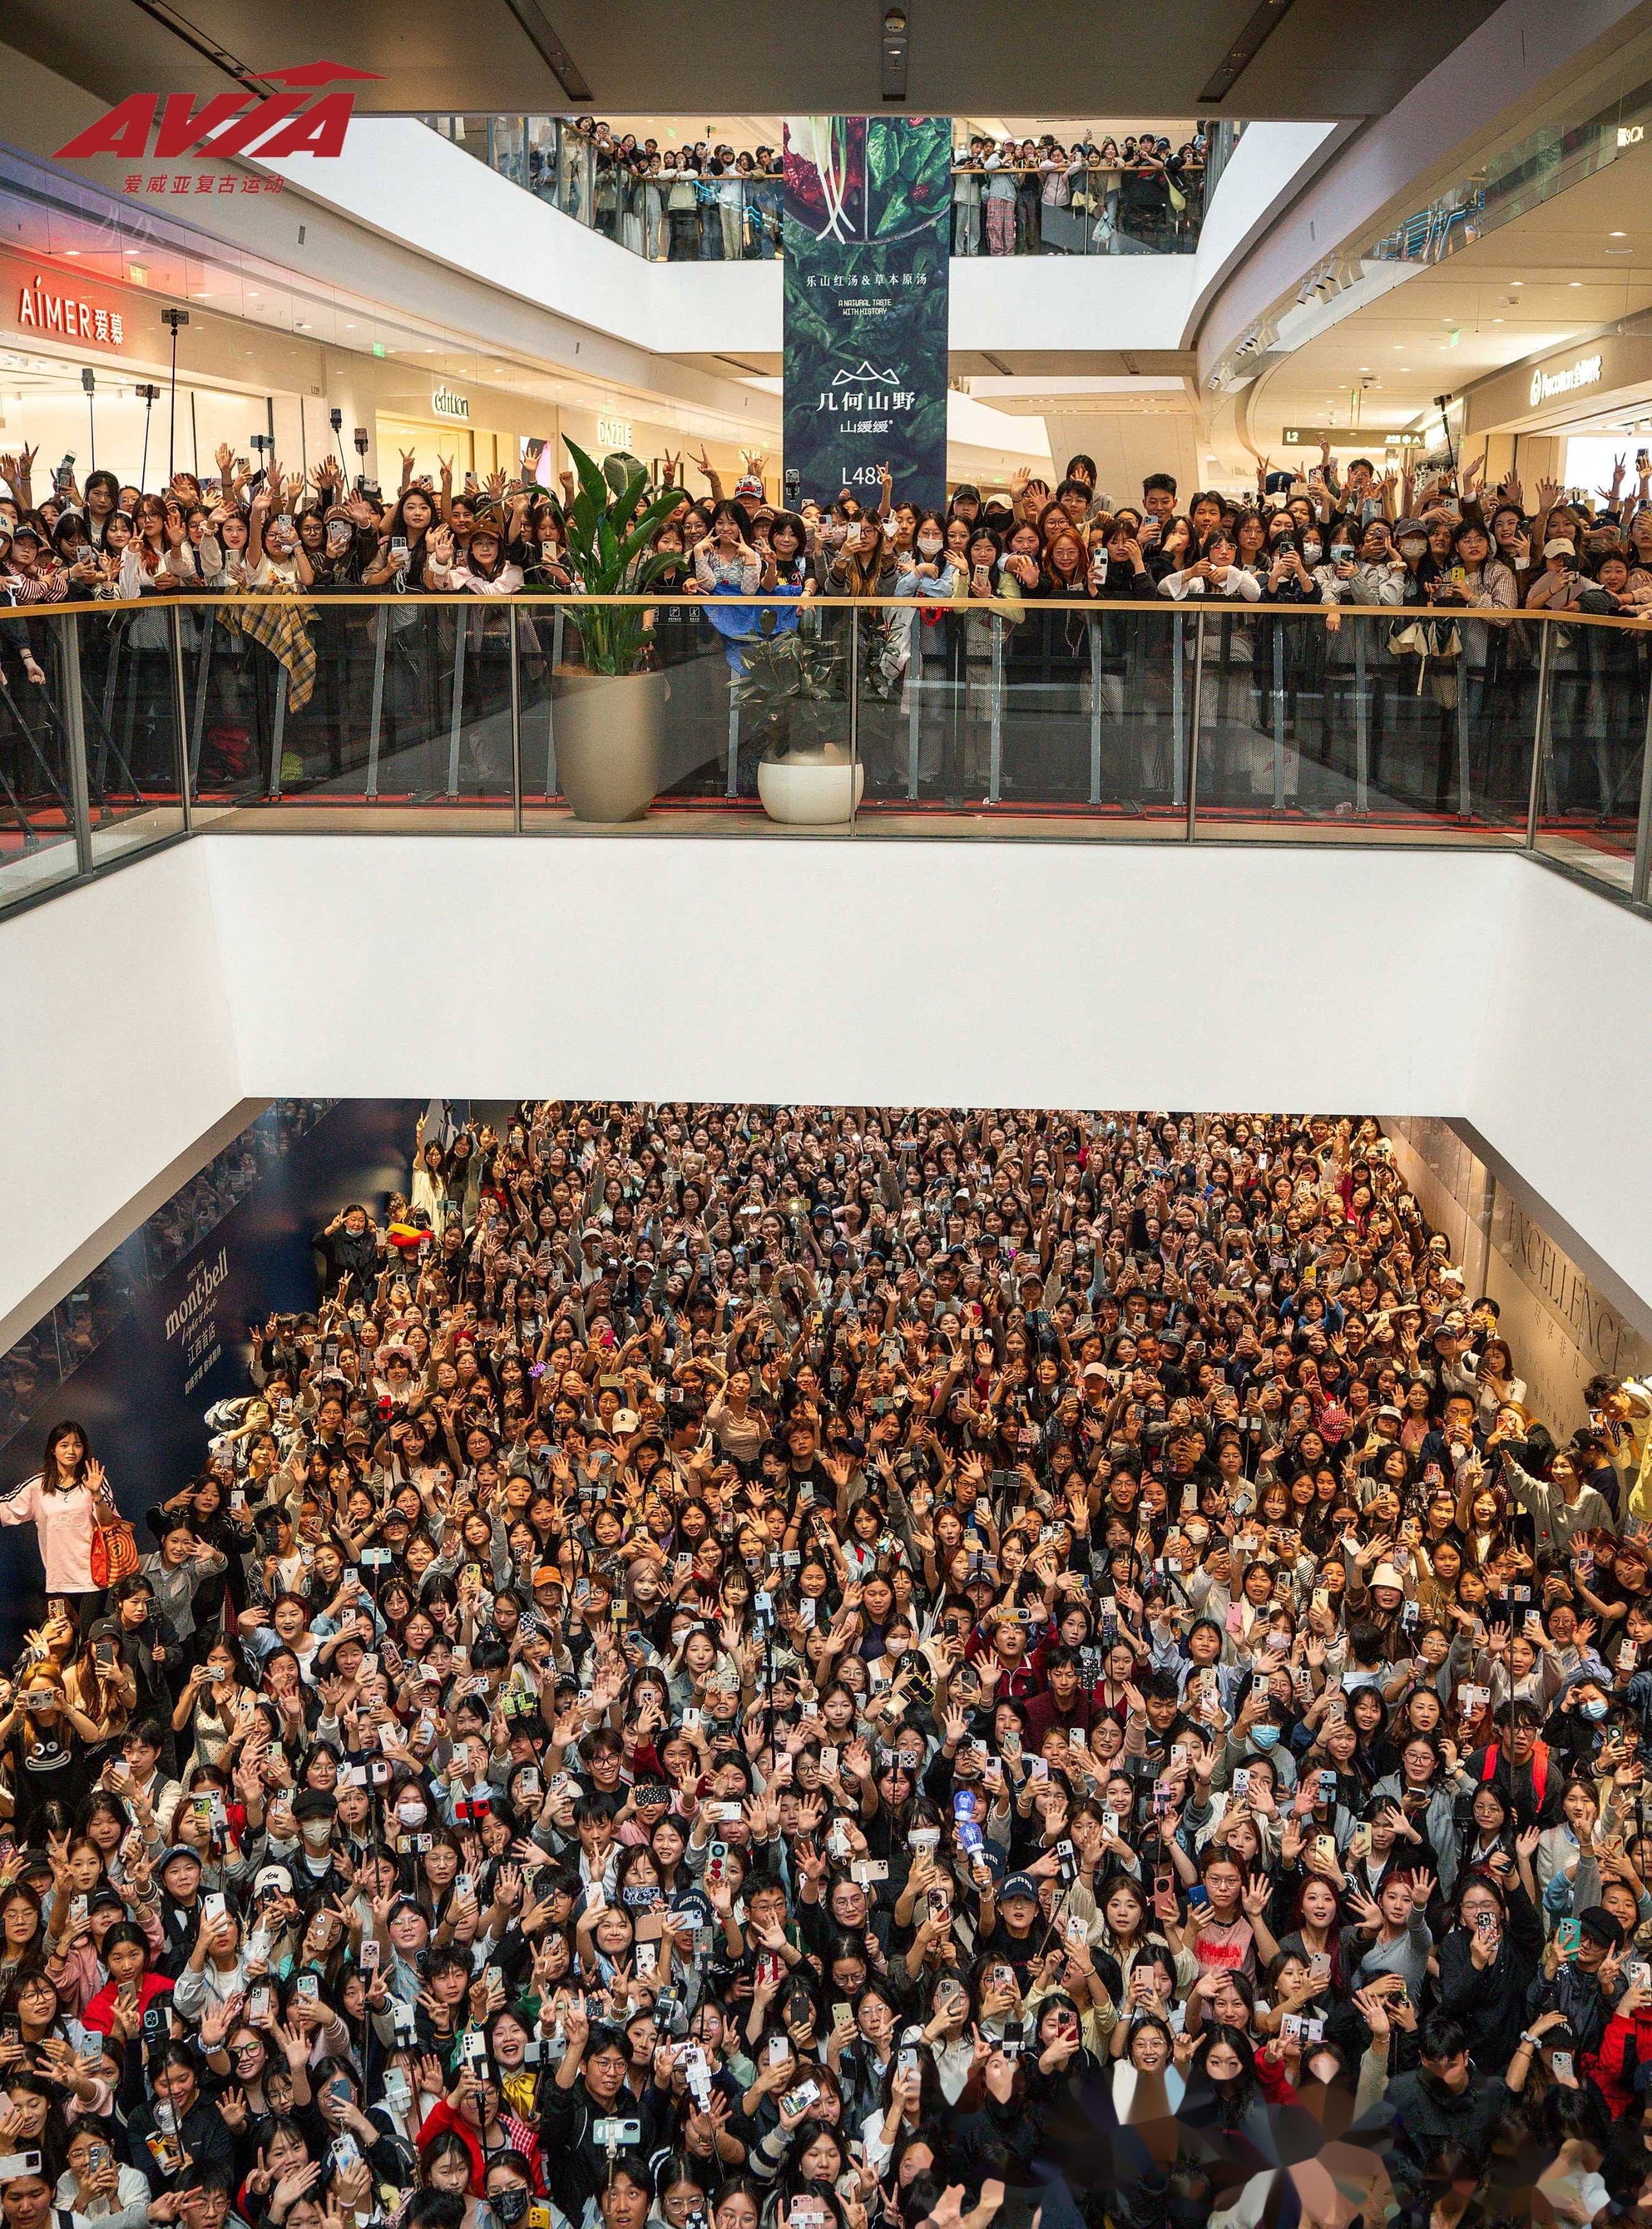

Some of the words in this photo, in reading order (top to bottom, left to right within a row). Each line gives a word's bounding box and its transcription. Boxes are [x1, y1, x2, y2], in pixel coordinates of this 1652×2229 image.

[843, 308, 859, 316] WITH
[92, 308, 124, 346] 爱慕
[435, 386, 469, 417] edition
[816, 391, 916, 411] 几何山野
[599, 421, 632, 446] DAZZLE
[1286, 430, 1299, 443] L2
[1, 516, 8, 528] LA
[188, 1321, 215, 1367] 江西首店
[620, 1413, 626, 1422] S
[693, 1895, 700, 1903] TO
